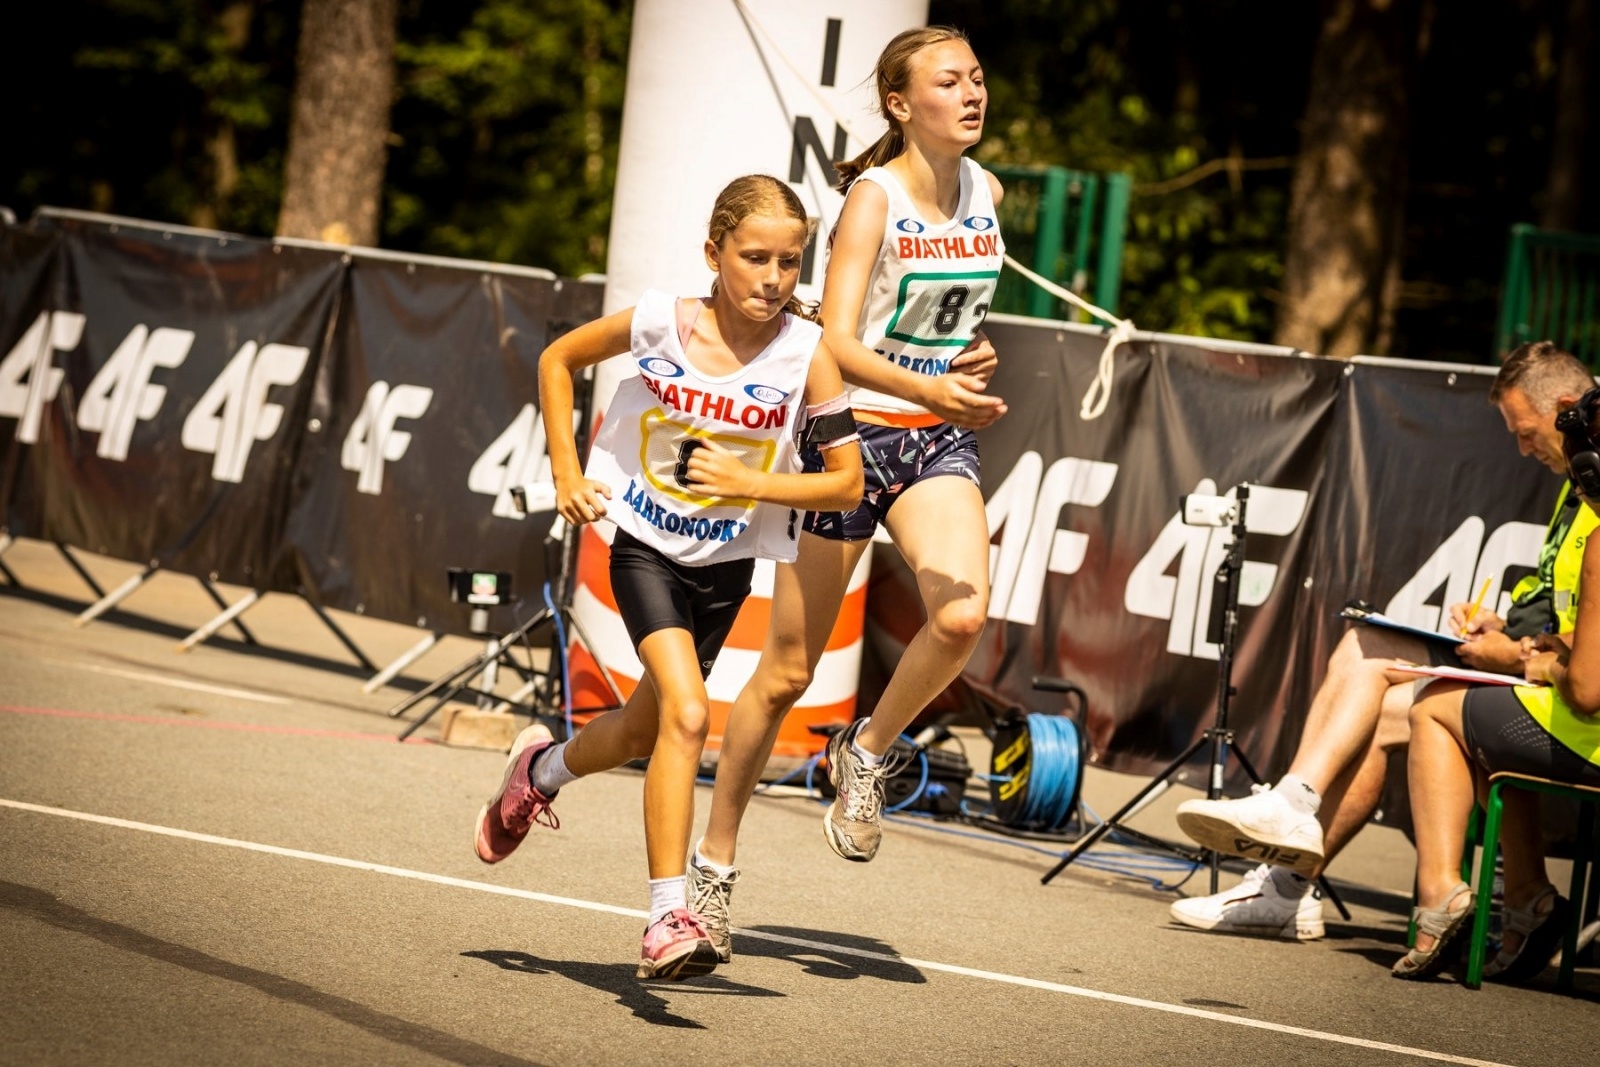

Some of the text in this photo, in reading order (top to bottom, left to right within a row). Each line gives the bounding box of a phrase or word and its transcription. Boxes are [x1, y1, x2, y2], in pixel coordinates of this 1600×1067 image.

[897, 234, 999, 260] BIATHLON
[0, 310, 86, 445] 4F
[77, 323, 196, 462] 4F
[181, 340, 310, 484] 4F
[341, 380, 434, 496] 4F
[1234, 838, 1301, 865] FILA
